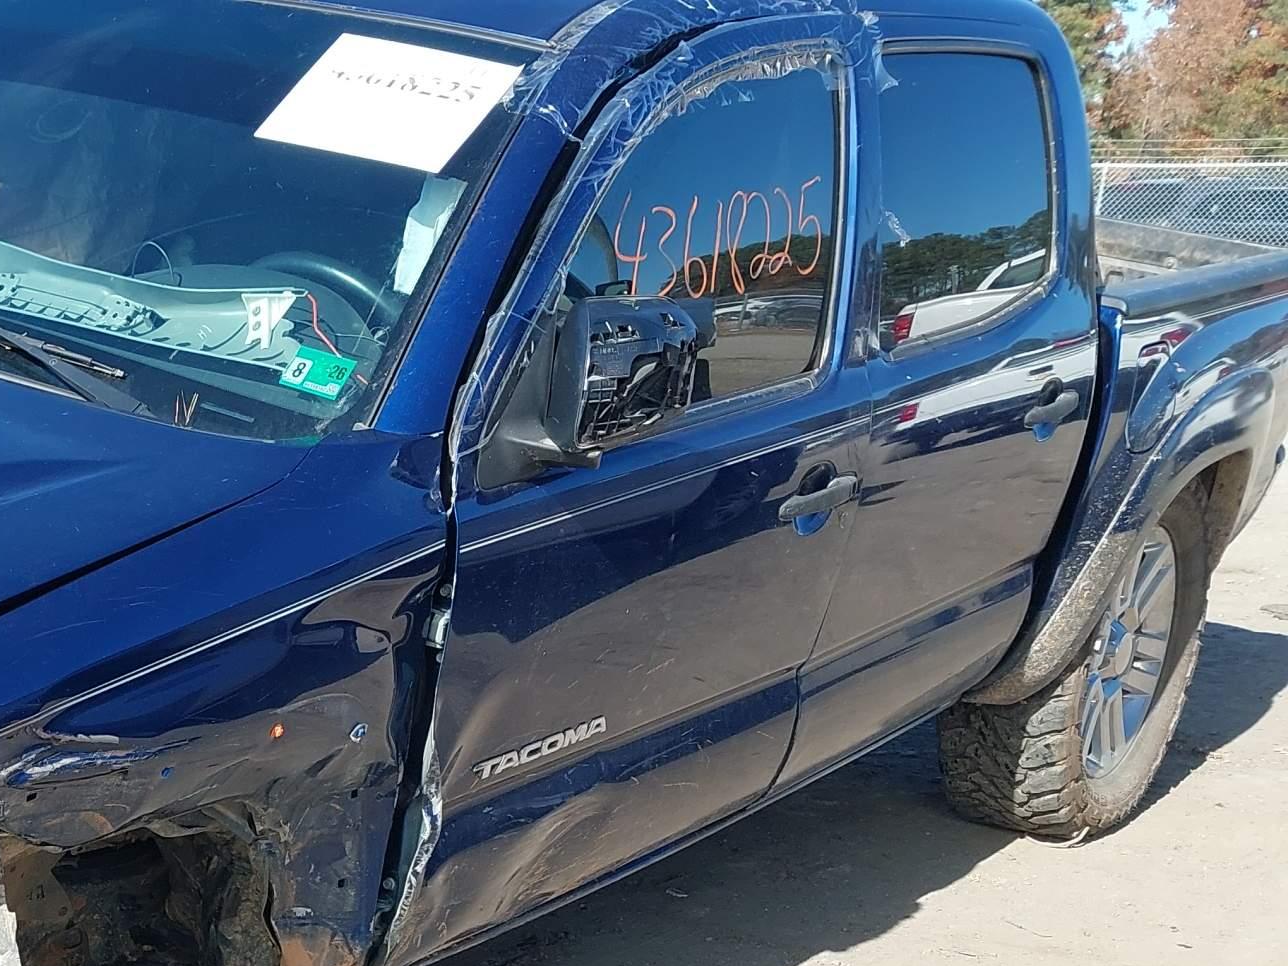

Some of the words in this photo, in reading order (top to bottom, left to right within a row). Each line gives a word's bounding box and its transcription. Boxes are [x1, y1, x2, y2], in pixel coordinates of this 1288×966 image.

[614, 175, 821, 298] 43618225
[292, 362, 306, 378] 8
[328, 364, 347, 380] 26
[472, 715, 607, 779] TACOMA
